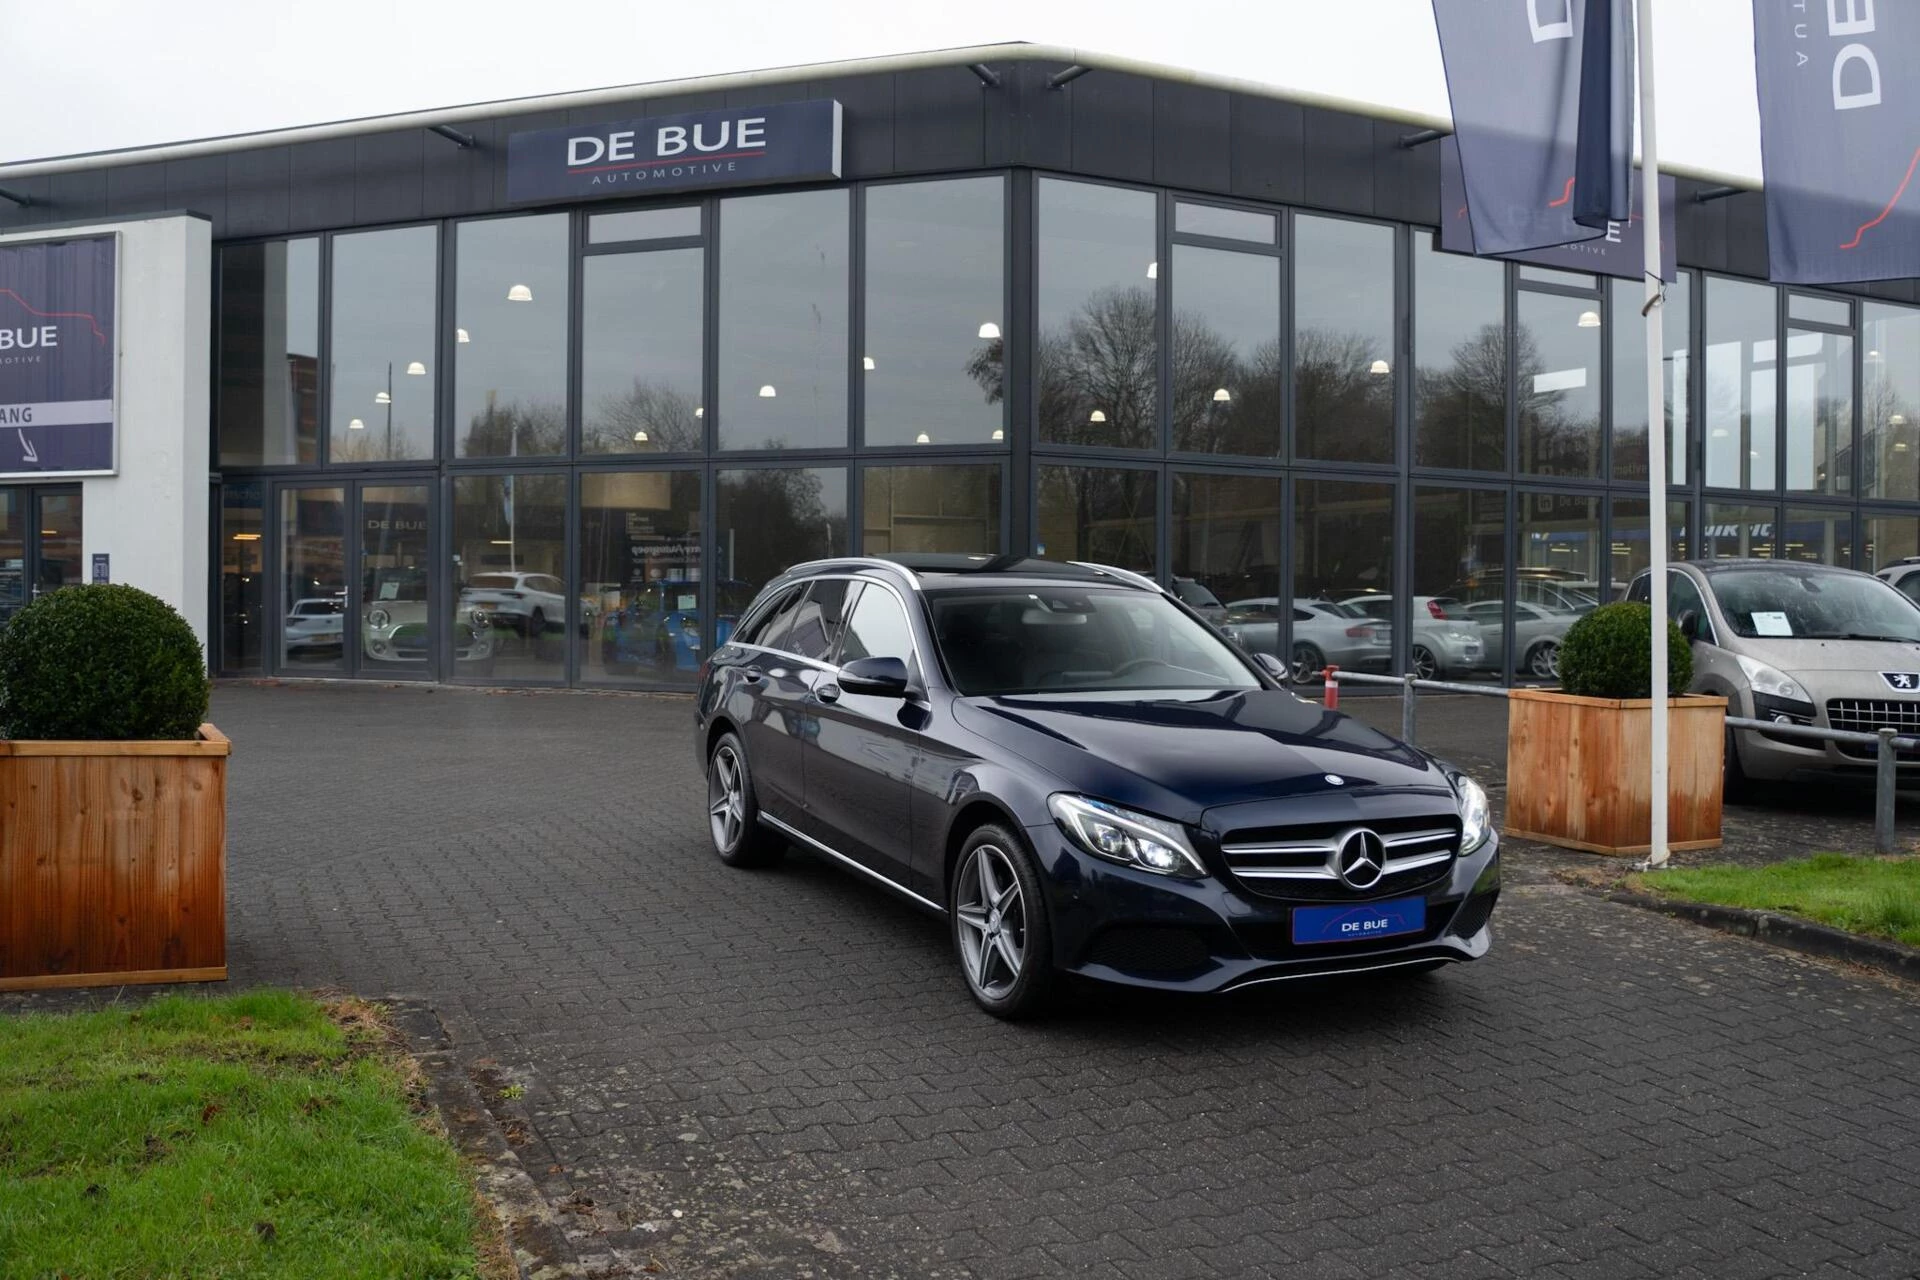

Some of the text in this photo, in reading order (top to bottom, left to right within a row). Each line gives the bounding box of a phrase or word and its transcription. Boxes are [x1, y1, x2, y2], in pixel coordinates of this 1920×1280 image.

[1793, 0, 1809, 66] AUT
[567, 118, 766, 166] DE BUE
[592, 162, 736, 184] AUTOMOTIVE
[0, 356, 41, 365] OTIVE
[0, 407, 32, 423] ANG
[367, 520, 390, 530] DE
[1341, 919, 1388, 932] DE BUE
